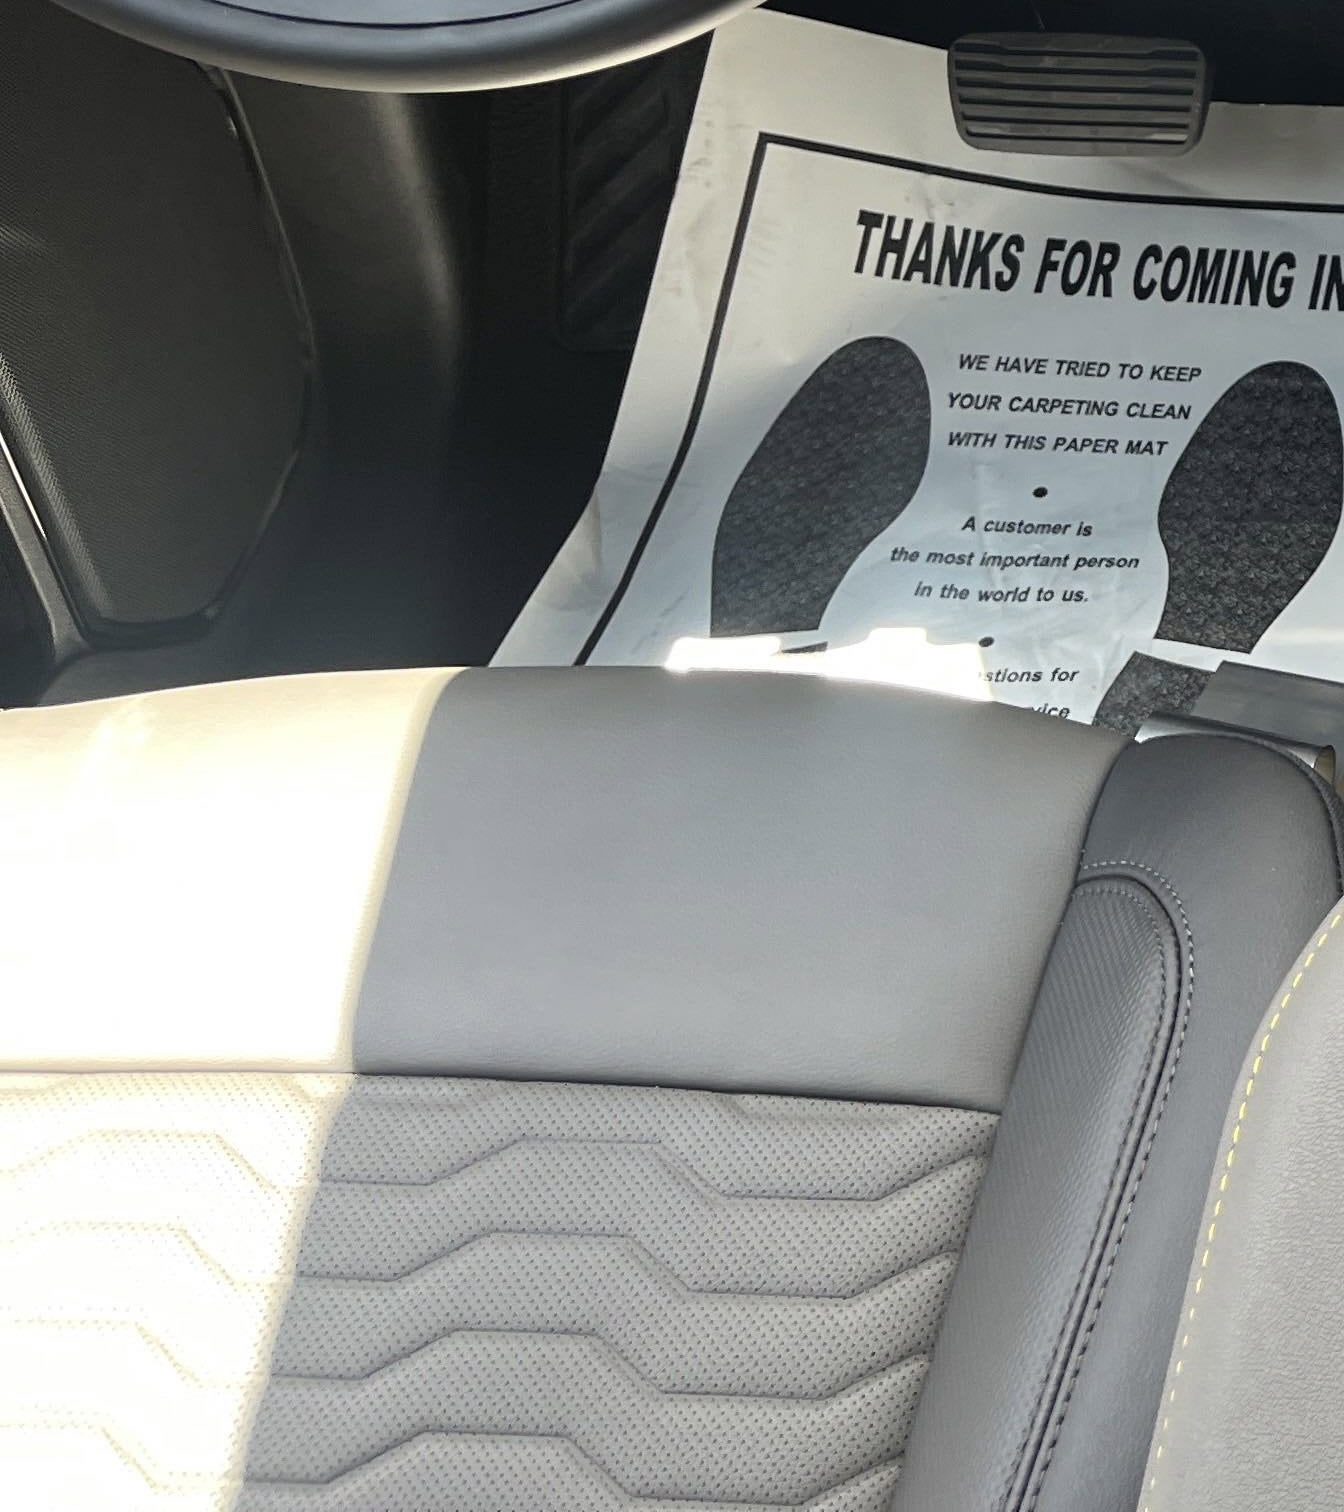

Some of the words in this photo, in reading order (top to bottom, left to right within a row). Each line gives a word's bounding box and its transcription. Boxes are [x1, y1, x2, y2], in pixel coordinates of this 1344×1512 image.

[854, 208, 1025, 293] THANKS
[1033, 236, 1121, 298] FOR
[1133, 243, 1297, 309] COMING
[958, 353, 990, 370] WE
[995, 356, 1049, 375] HAVE
[1055, 358, 1111, 378] TRIED
[1117, 362, 1144, 380] TO
[1149, 365, 1202, 383] KEEP
[948, 392, 1003, 412] YOUR
[1008, 395, 1120, 417] CARPETING
[1126, 402, 1192, 421] CLEAN
[947, 431, 998, 449] WITH
[1004, 433, 1047, 451] THIS
[1052, 436, 1120, 455] PAPER
[1125, 439, 1169, 456] MAT
[961, 515, 976, 532] A
[983, 518, 1072, 536] customer
[1076, 521, 1093, 537] is
[890, 546, 920, 563] the
[925, 551, 975, 567] most
[979, 552, 1070, 571] important
[1073, 555, 1140, 572] person
[914, 581, 933, 597] in
[939, 583, 970, 600] the
[978, 586, 1032, 603] world
[1036, 587, 1055, 603] to
[1062, 588, 1089, 603] us.
[1050, 667, 1080, 682] for
